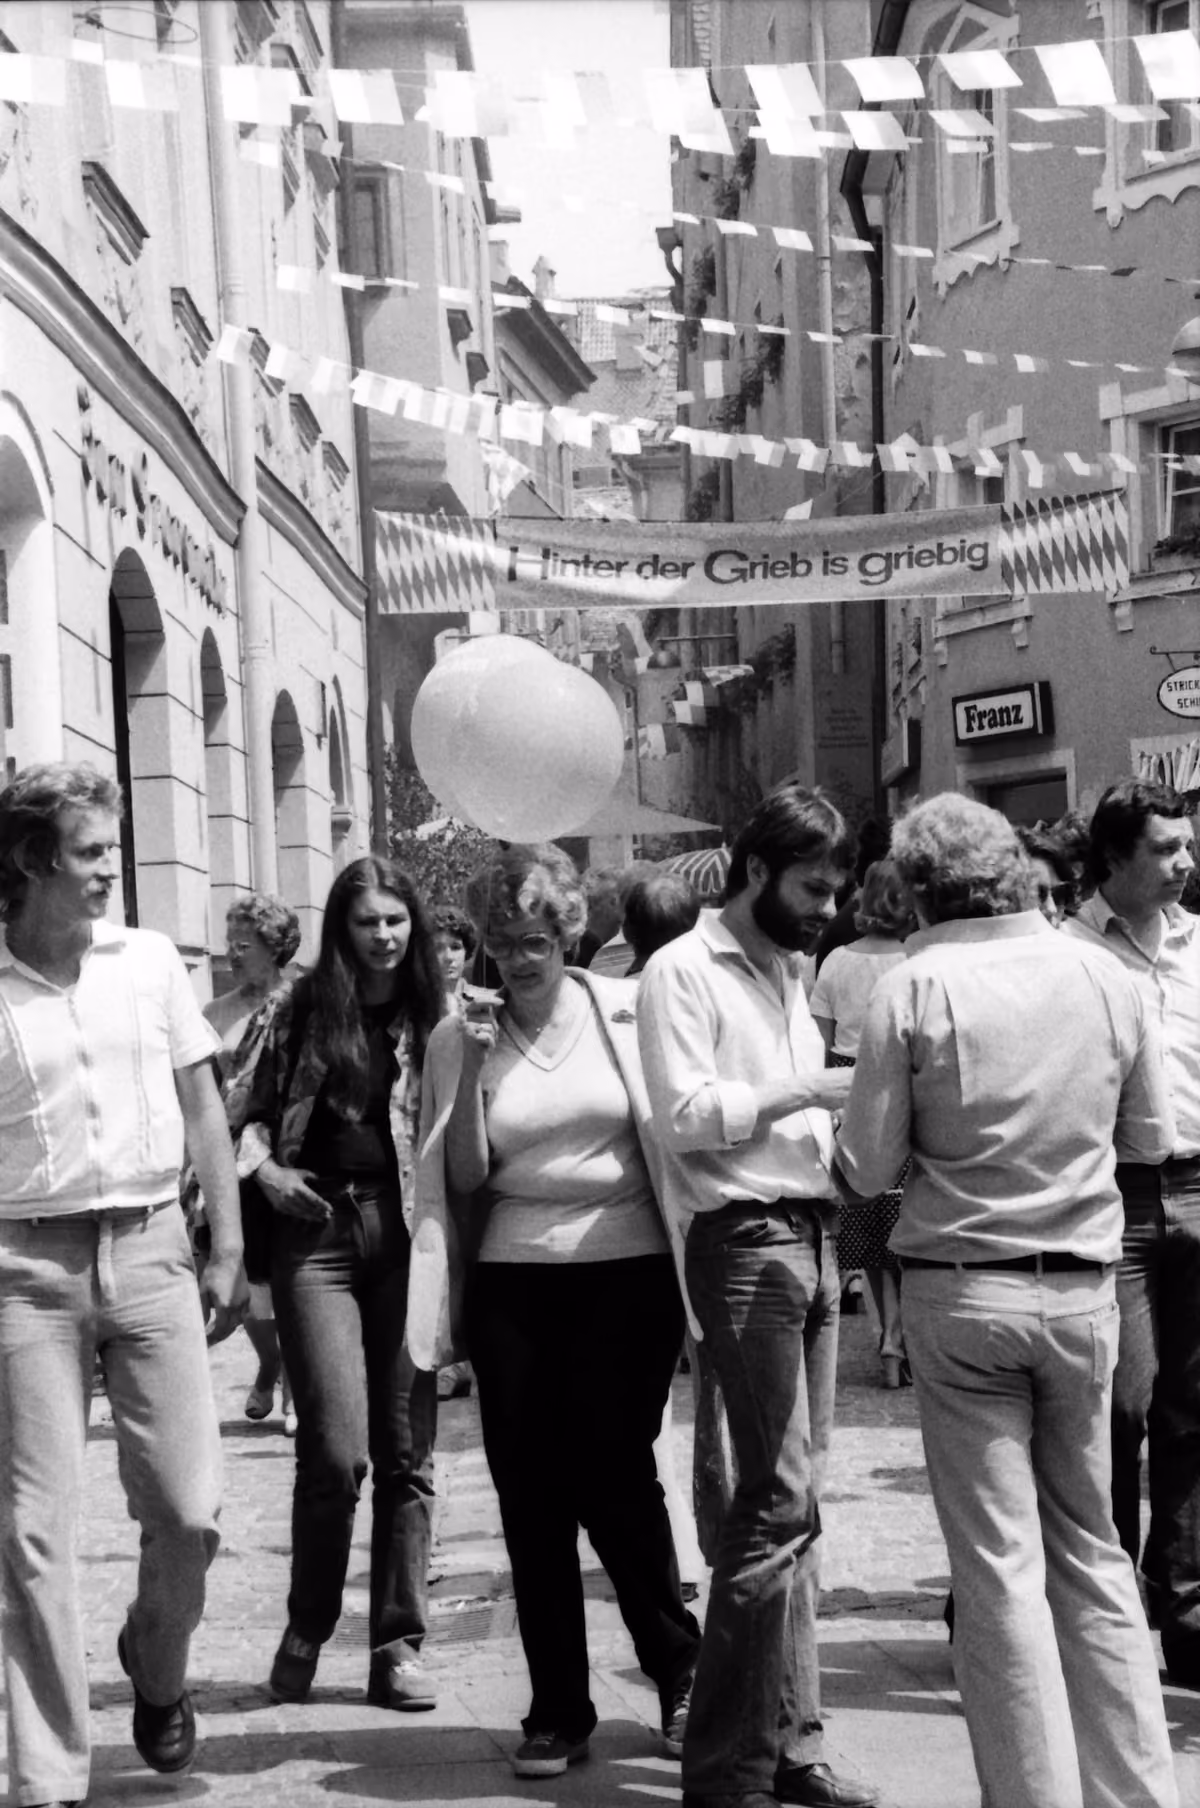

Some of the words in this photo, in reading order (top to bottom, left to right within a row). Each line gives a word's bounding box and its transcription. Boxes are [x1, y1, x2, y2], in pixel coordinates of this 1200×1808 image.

[508, 546, 629, 581] Hinter
[635, 554, 696, 579] der
[704, 549, 812, 584] Grieb
[822, 550, 849, 577] is
[857, 538, 989, 586] griebig
[964, 704, 1024, 733] Franz
